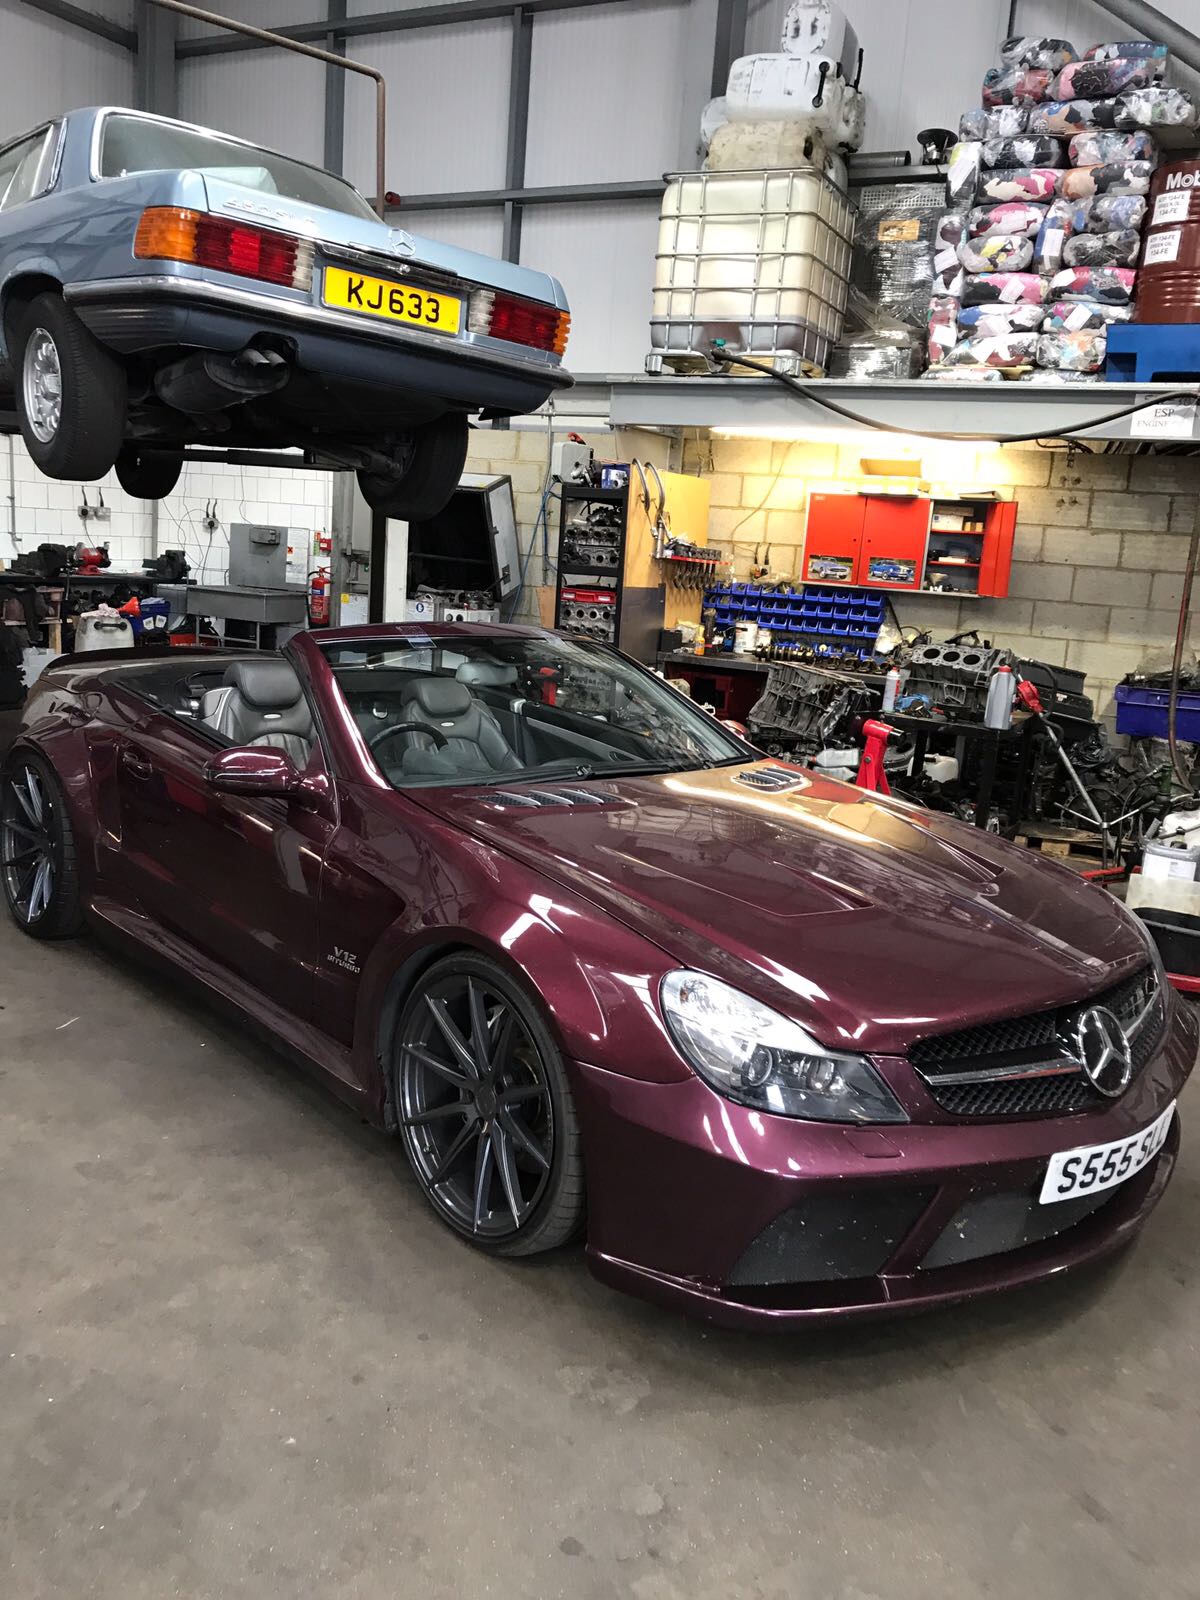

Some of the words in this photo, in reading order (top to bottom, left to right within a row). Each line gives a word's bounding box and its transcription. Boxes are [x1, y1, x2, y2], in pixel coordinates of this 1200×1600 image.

[1150, 247, 1169, 255] 134-FE
[347, 276, 441, 323] KJ633
[1154, 408, 1175, 418] ESP
[334, 946, 357, 964] V12
[1056, 1140, 1138, 1194] S555
